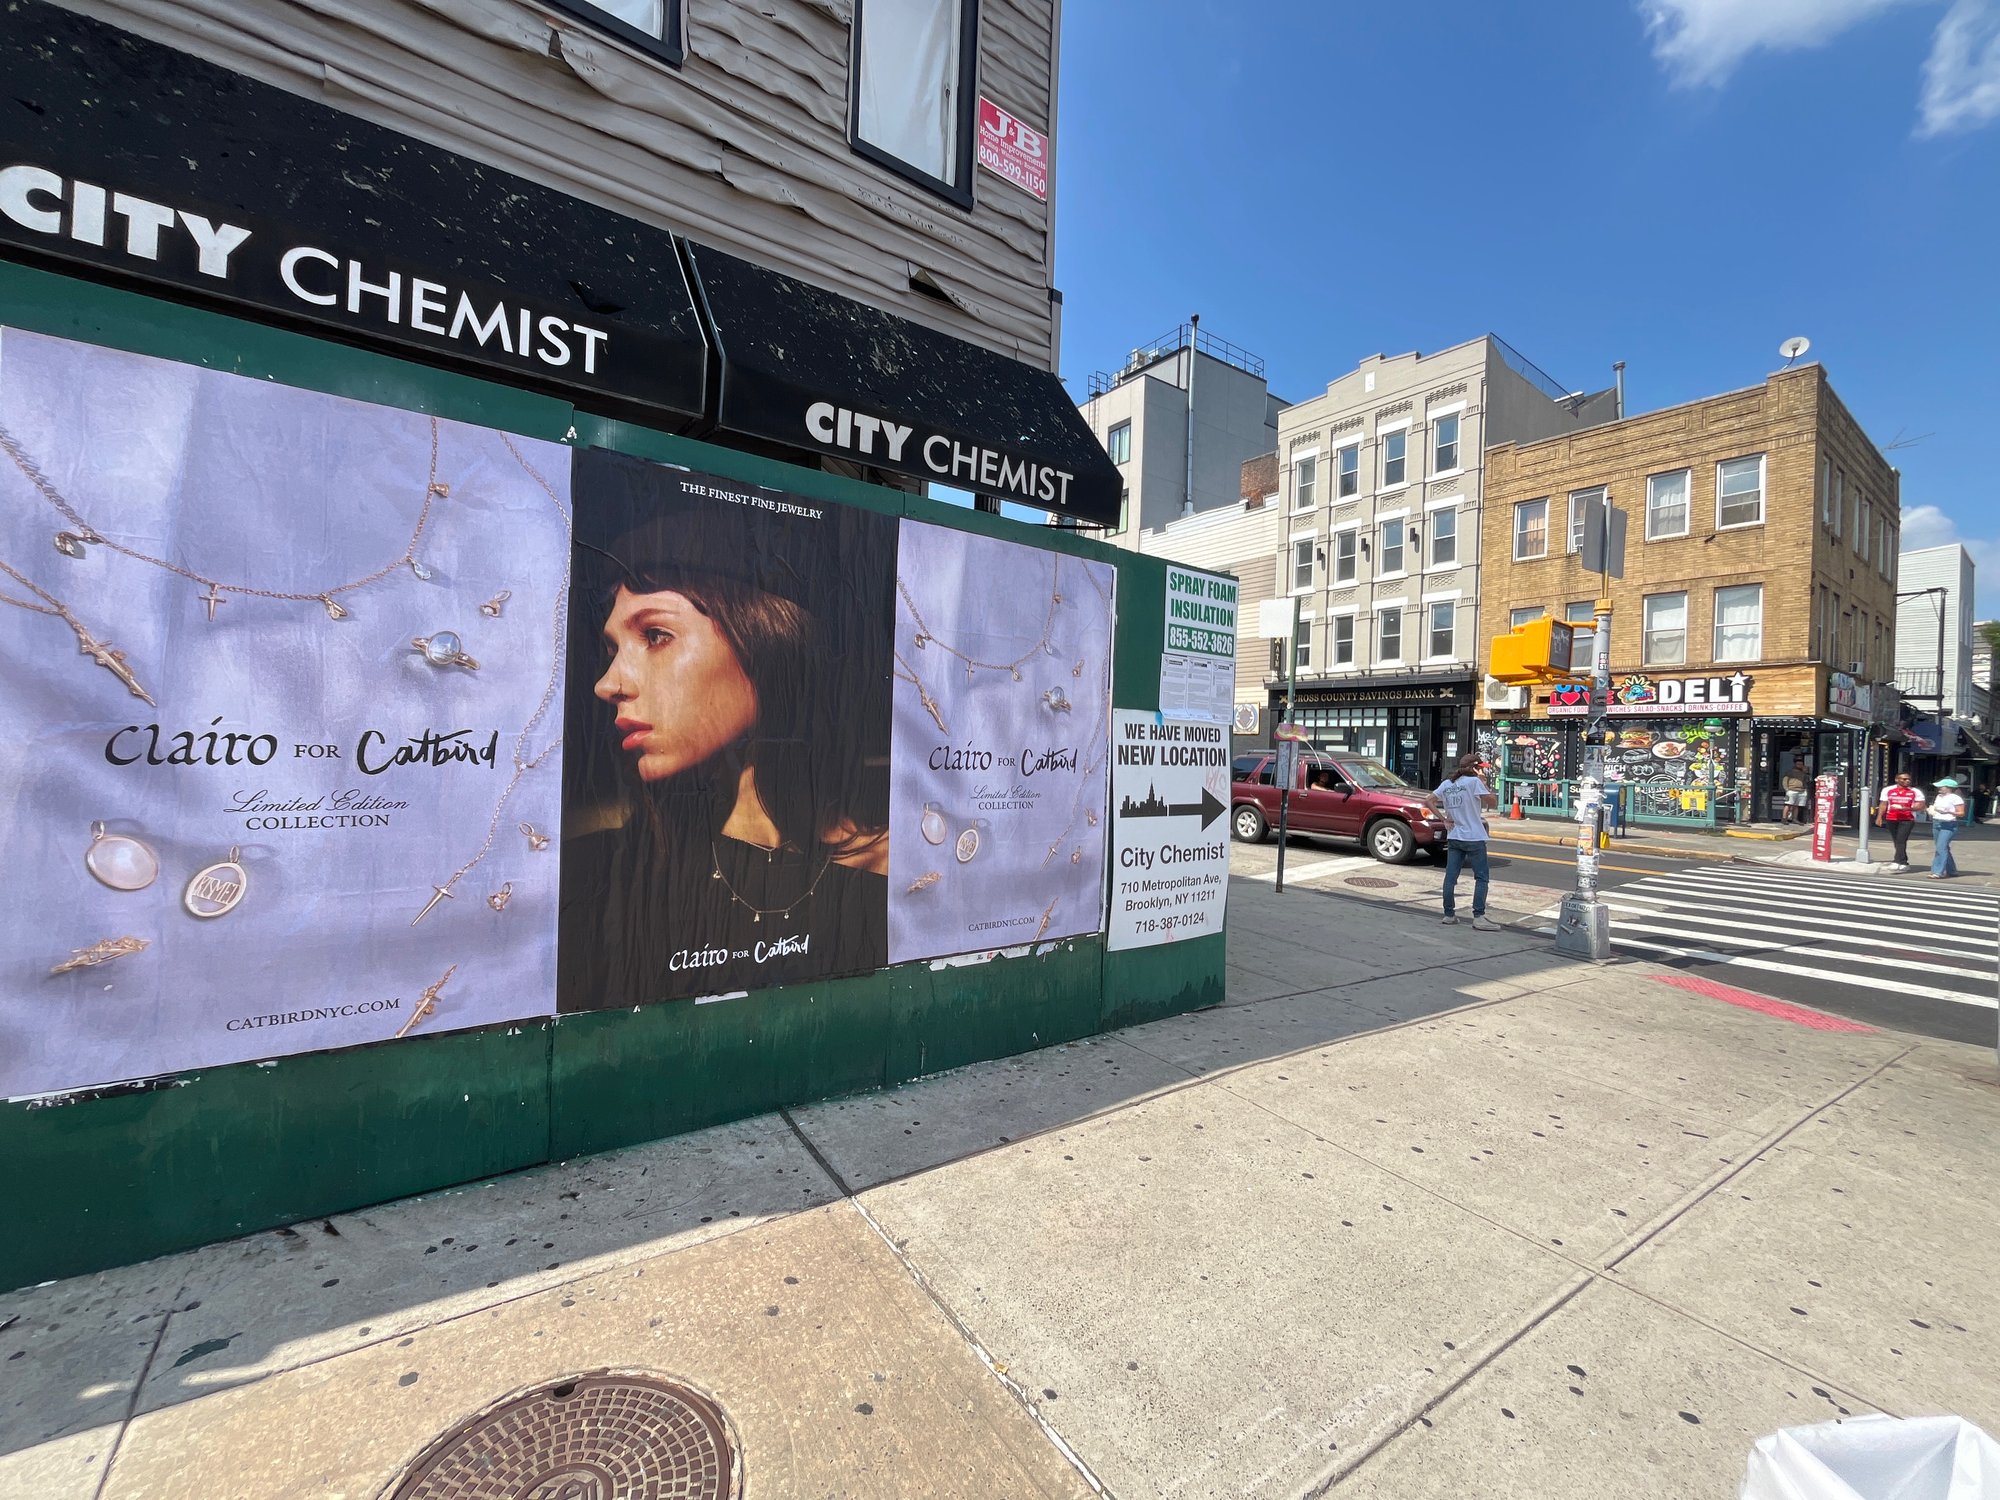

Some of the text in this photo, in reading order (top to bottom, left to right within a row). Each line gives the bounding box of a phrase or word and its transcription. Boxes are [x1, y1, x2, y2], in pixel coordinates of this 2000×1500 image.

[980, 125, 1046, 170] Home Improvements
[980, 144, 1046, 193] 800-599-1150
[0, 165, 608, 374] CITY CHEMIST
[805, 401, 1074, 505] CITY CHEMIST
[680, 481, 823, 520] THE FINEST FINE JEWELRY
[1169, 571, 1236, 603] SPRAY FOAM
[1170, 598, 1234, 628] INSULATION
[1169, 626, 1233, 655] 855-552-3626
[1321, 692, 1358, 702] COUNTY
[1359, 690, 1402, 701] SAVINGS
[1405, 688, 1435, 699] BANK
[1548, 706, 1573, 714] ORGANIC
[1125, 723, 1220, 742] WE HAVE MOVED
[294, 744, 341, 759] FOR
[356, 728, 499, 775] Catbird
[997, 757, 1016, 767] FOR
[1021, 747, 1078, 777] Catbird
[1118, 745, 1226, 767] NEW LOCATION
[223, 788, 409, 814] Limited Edition
[970, 784, 1042, 801] Limited Edition
[978, 800, 1034, 811] COLLECTION
[245, 814, 390, 831] COLLECTION
[1121, 842, 1224, 870] City Chemist
[1121, 874, 1222, 894] 710 Metropolitan Ave,
[1125, 890, 1215, 911] Brooklyn, NY 11211
[968, 916, 1035, 932] CATBIRDNYC.COM
[1136, 912, 1204, 933] 718-387-0124
[732, 949, 750, 959] FOR
[754, 934, 811, 965] Catbird
[225, 998, 401, 1032] CATBIRDNYC.COM
